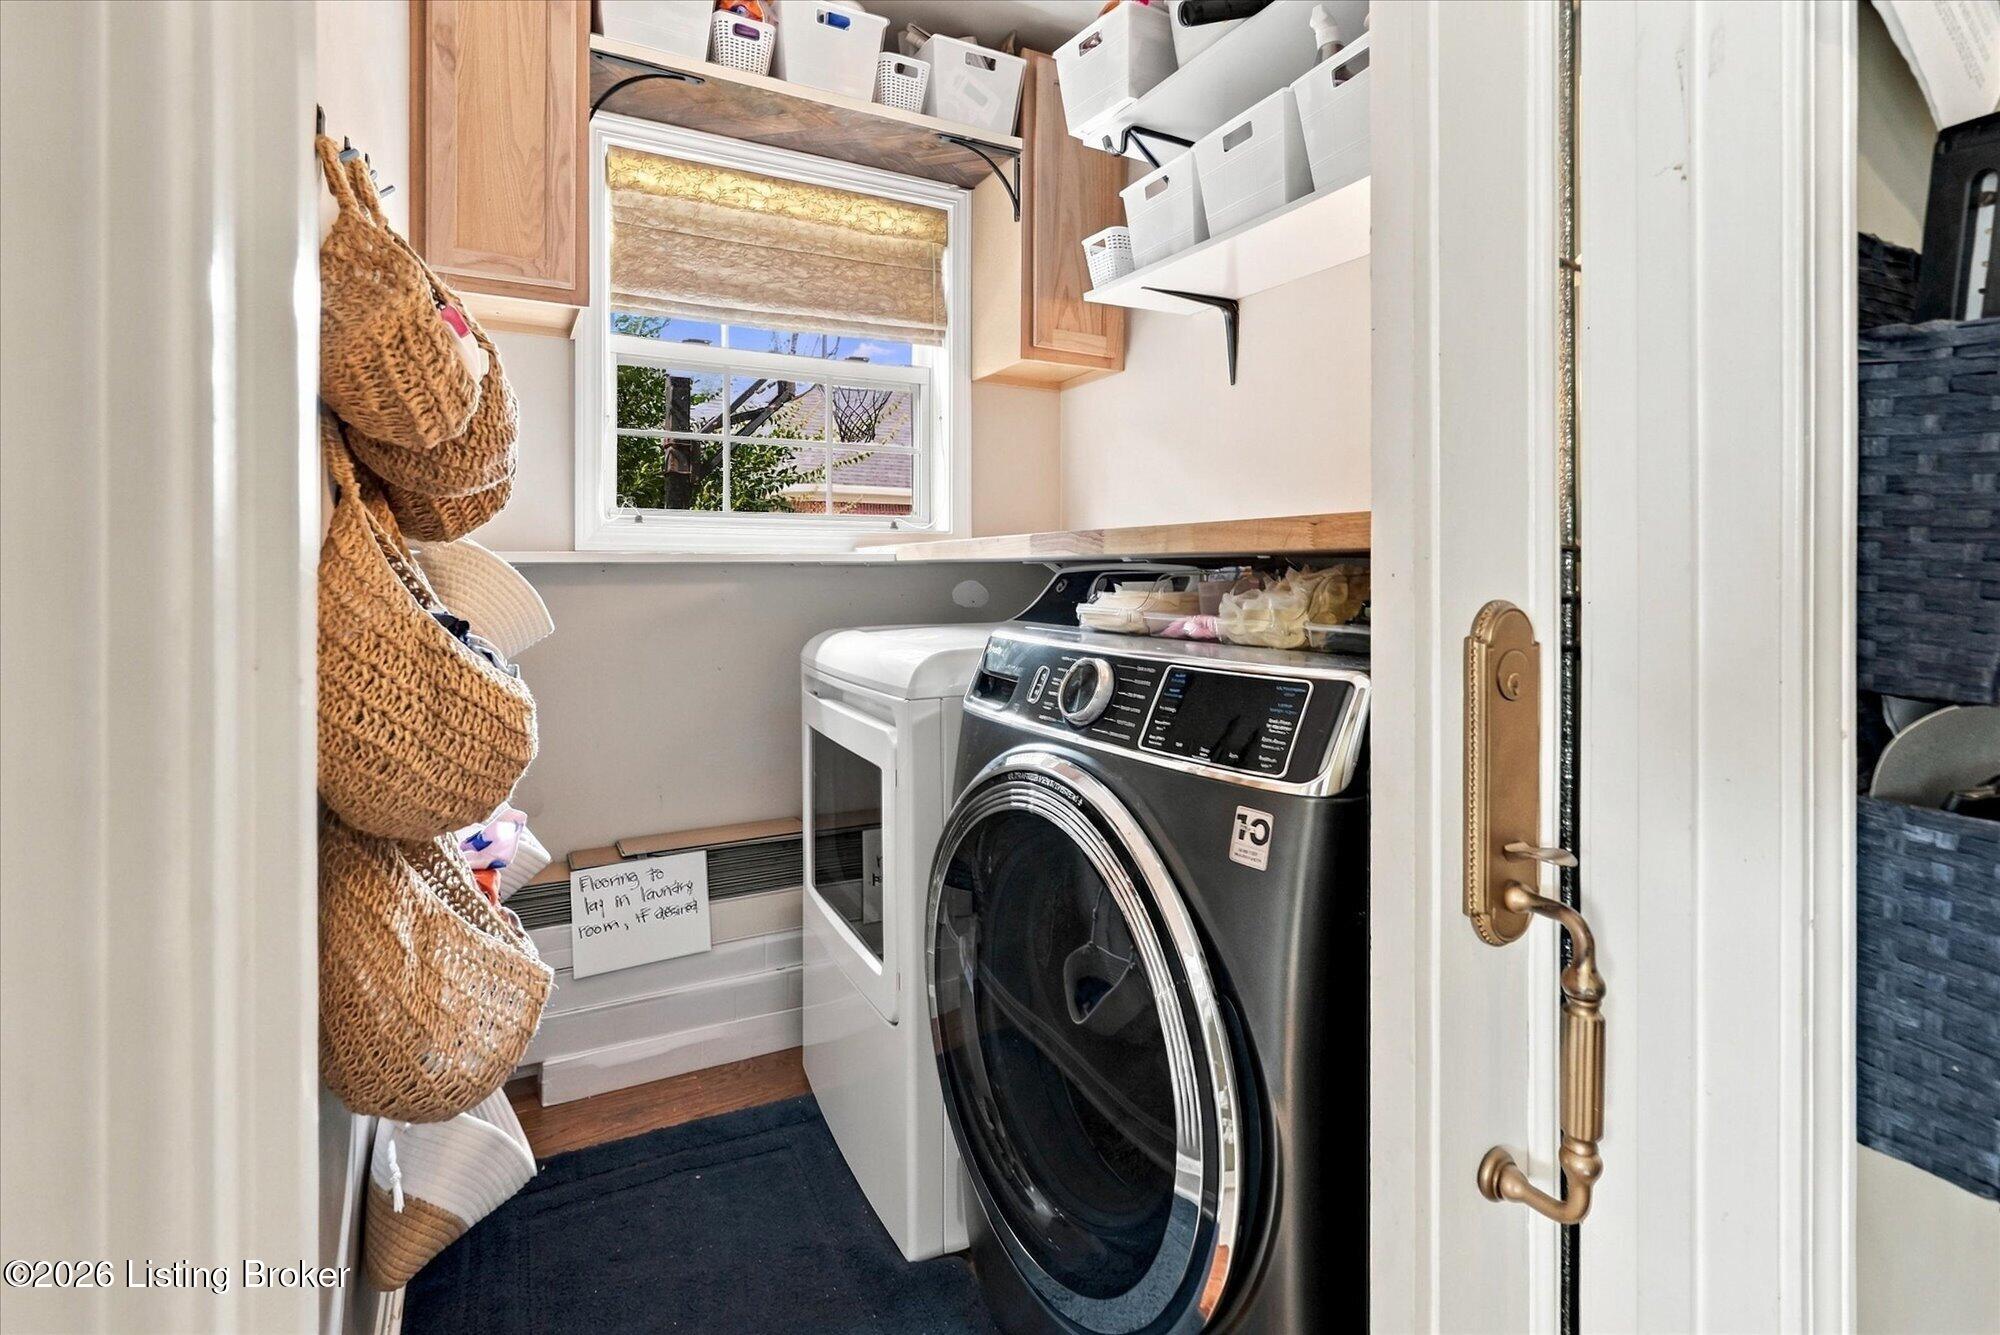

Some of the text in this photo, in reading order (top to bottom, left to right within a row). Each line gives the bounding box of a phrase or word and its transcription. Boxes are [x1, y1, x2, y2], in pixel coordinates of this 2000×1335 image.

[579, 867, 664, 892] Flooring to
[584, 879, 693, 918] lay in laundry
[578, 920, 629, 939] room,
[654, 898, 698, 920] desired
